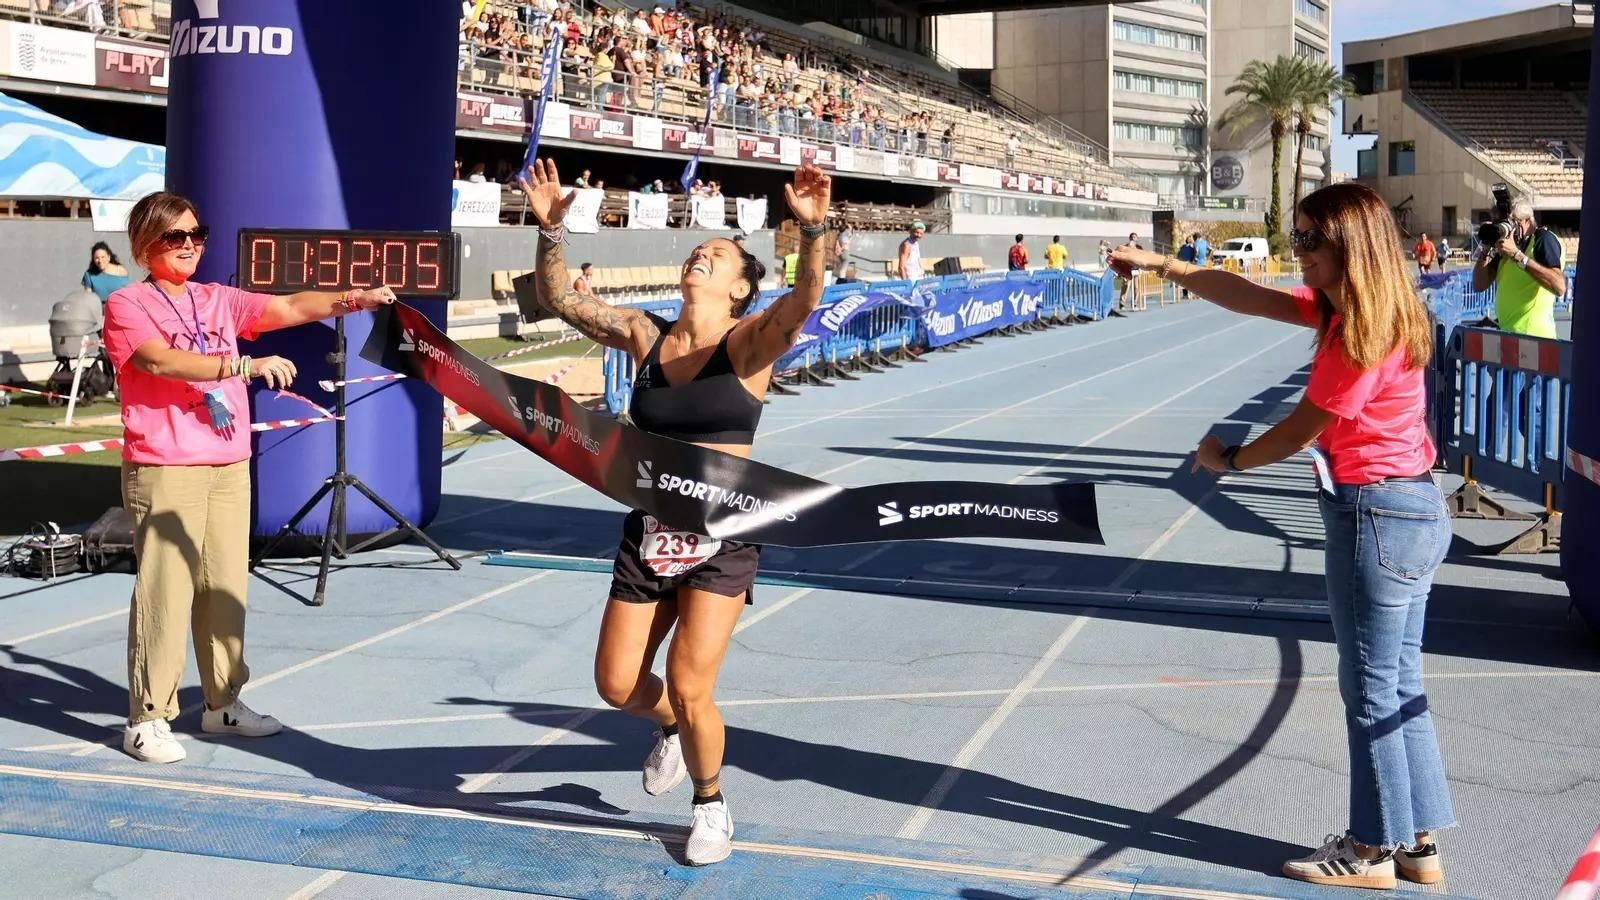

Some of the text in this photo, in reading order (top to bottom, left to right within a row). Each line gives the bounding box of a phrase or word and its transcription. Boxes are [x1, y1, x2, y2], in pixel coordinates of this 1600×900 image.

[105, 50, 160, 76] PLAY
[460, 100, 488, 117] PLAY
[573, 116, 599, 130] PLAY
[251, 239, 440, 289] 01:32:05
[418, 339, 480, 387] SPORTMADNESS
[525, 406, 600, 455] SPORTMADNESS
[908, 502, 1059, 523] SPORTMADNESS
[655, 533, 699, 555] 239
